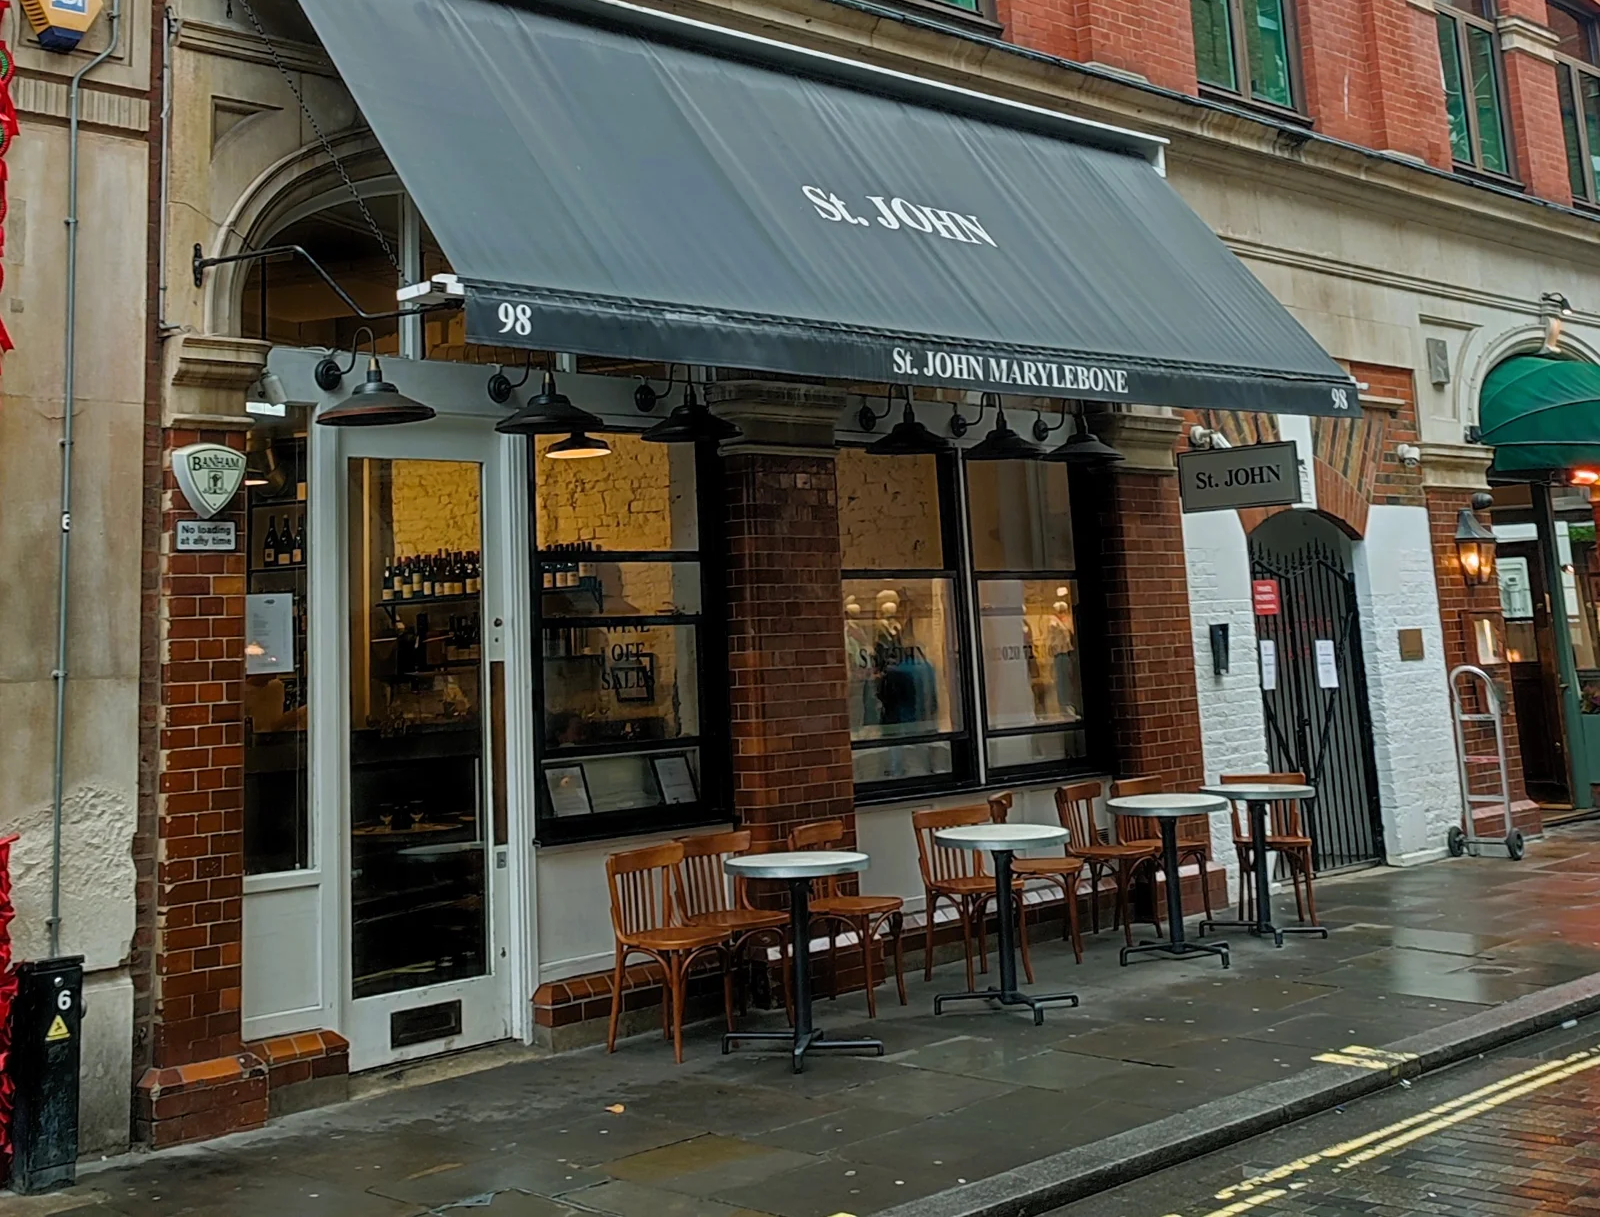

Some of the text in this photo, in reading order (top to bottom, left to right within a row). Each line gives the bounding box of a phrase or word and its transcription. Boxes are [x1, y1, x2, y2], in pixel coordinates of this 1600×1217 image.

[801, 185, 998, 248] St. JOHN
[497, 302, 532, 336] 98
[892, 347, 1129, 394] St. JOHN MARYLEBONE
[1331, 387, 1349, 410] 98
[191, 454, 240, 471] BANHAM
[1195, 465, 1281, 489] St. JOHN
[181, 524, 232, 536] No loading
[180, 536, 232, 547] at any time
[611, 642, 645, 662] OFF
[57, 989, 72, 1011] 6
